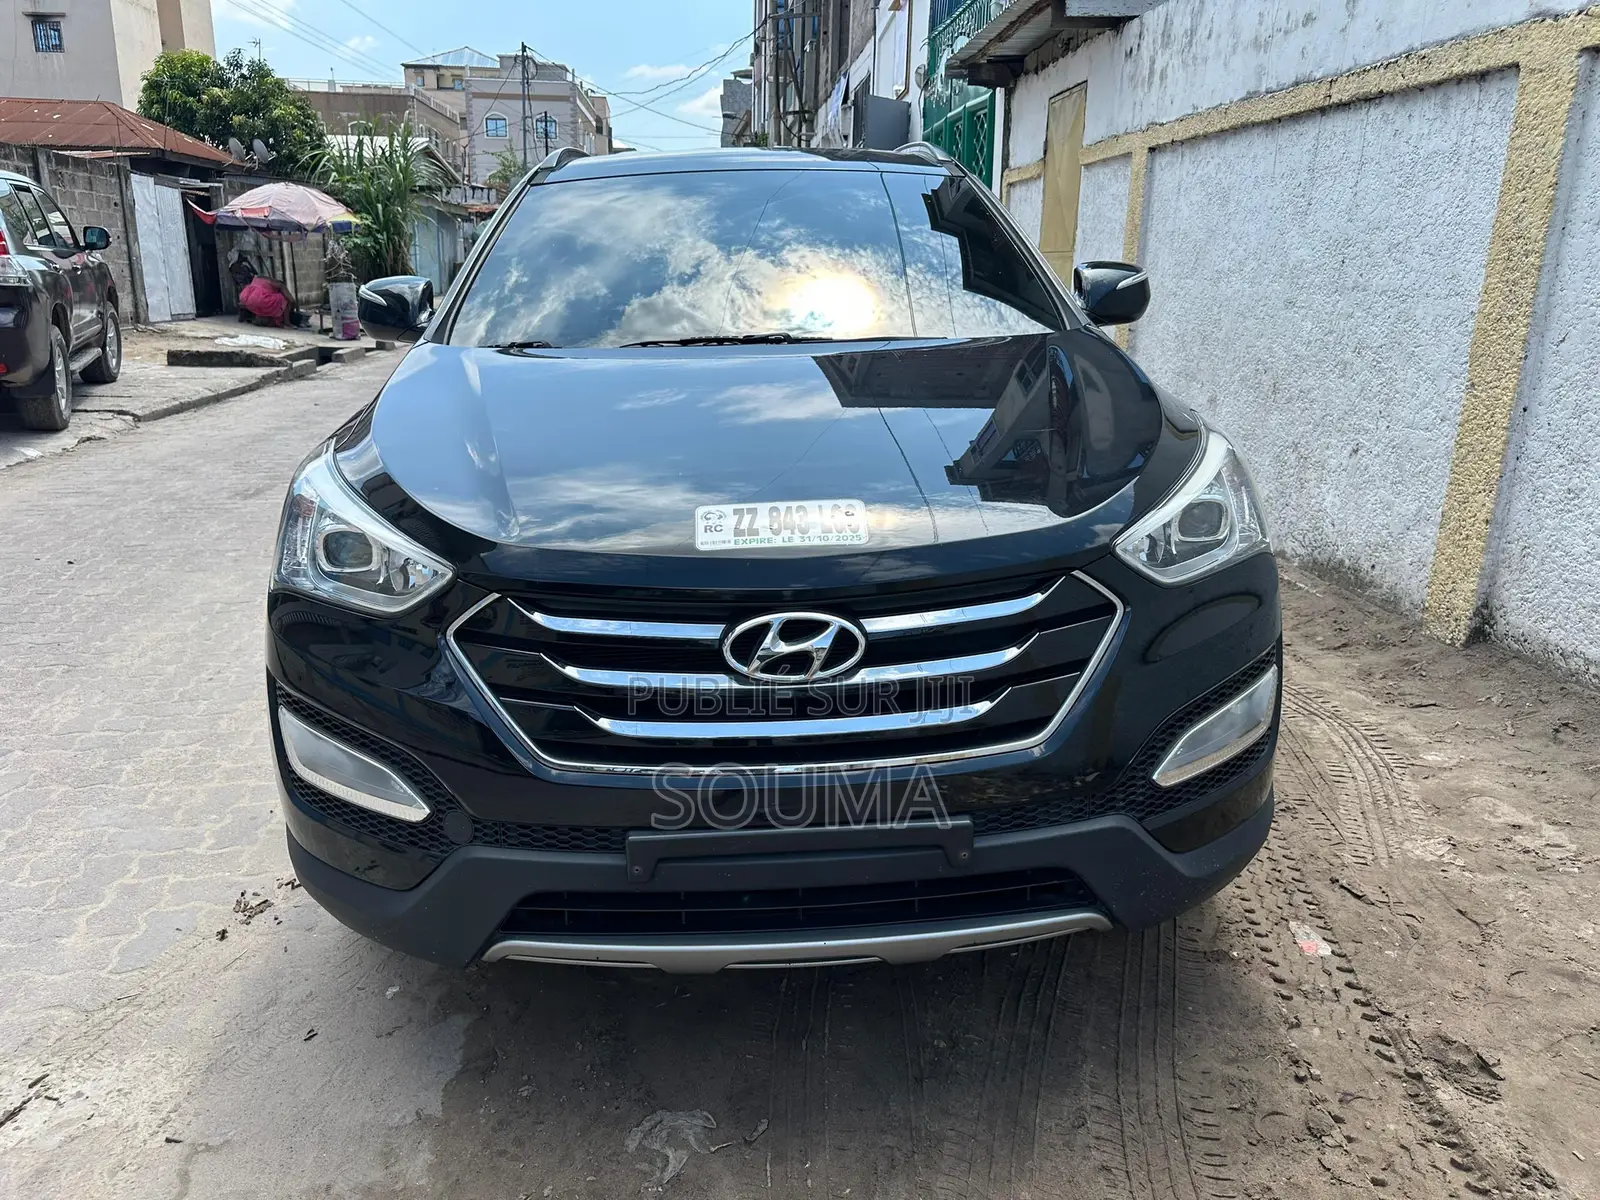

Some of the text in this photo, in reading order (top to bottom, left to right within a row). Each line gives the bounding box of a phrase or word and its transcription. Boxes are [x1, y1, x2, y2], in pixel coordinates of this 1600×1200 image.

[732, 507, 760, 538] ZZ
[704, 524, 724, 534] RC
[799, 534, 862, 543] 31/10/2025
